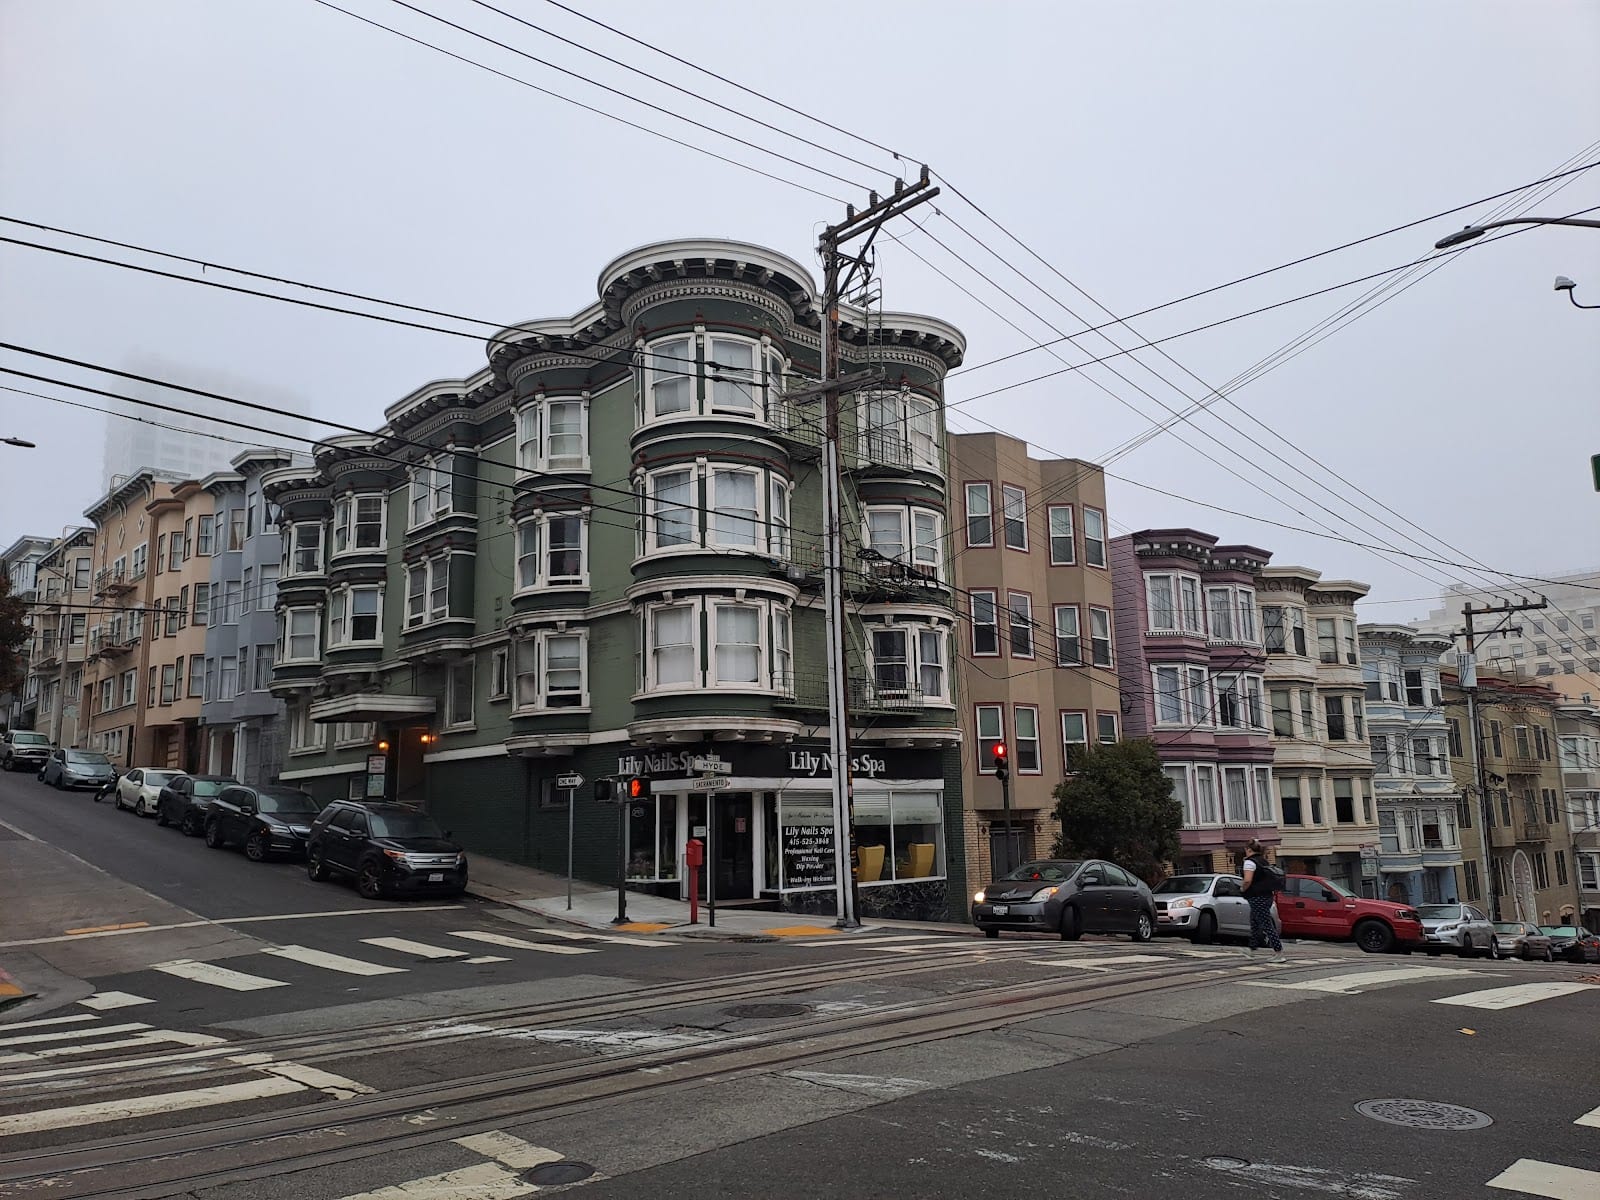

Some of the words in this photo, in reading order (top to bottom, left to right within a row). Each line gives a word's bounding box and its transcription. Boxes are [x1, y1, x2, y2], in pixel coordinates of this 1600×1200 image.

[618, 756, 643, 776] Lily
[644, 752, 679, 773] Nails
[703, 762, 725, 771] HYDE
[790, 751, 820, 776] Lily
[861, 754, 886, 777] Spa
[695, 779, 725, 788] SACRAMENTO
[785, 826, 799, 837] Lily
[801, 826, 819, 835] Nails
[820, 826, 833, 837] Spa
